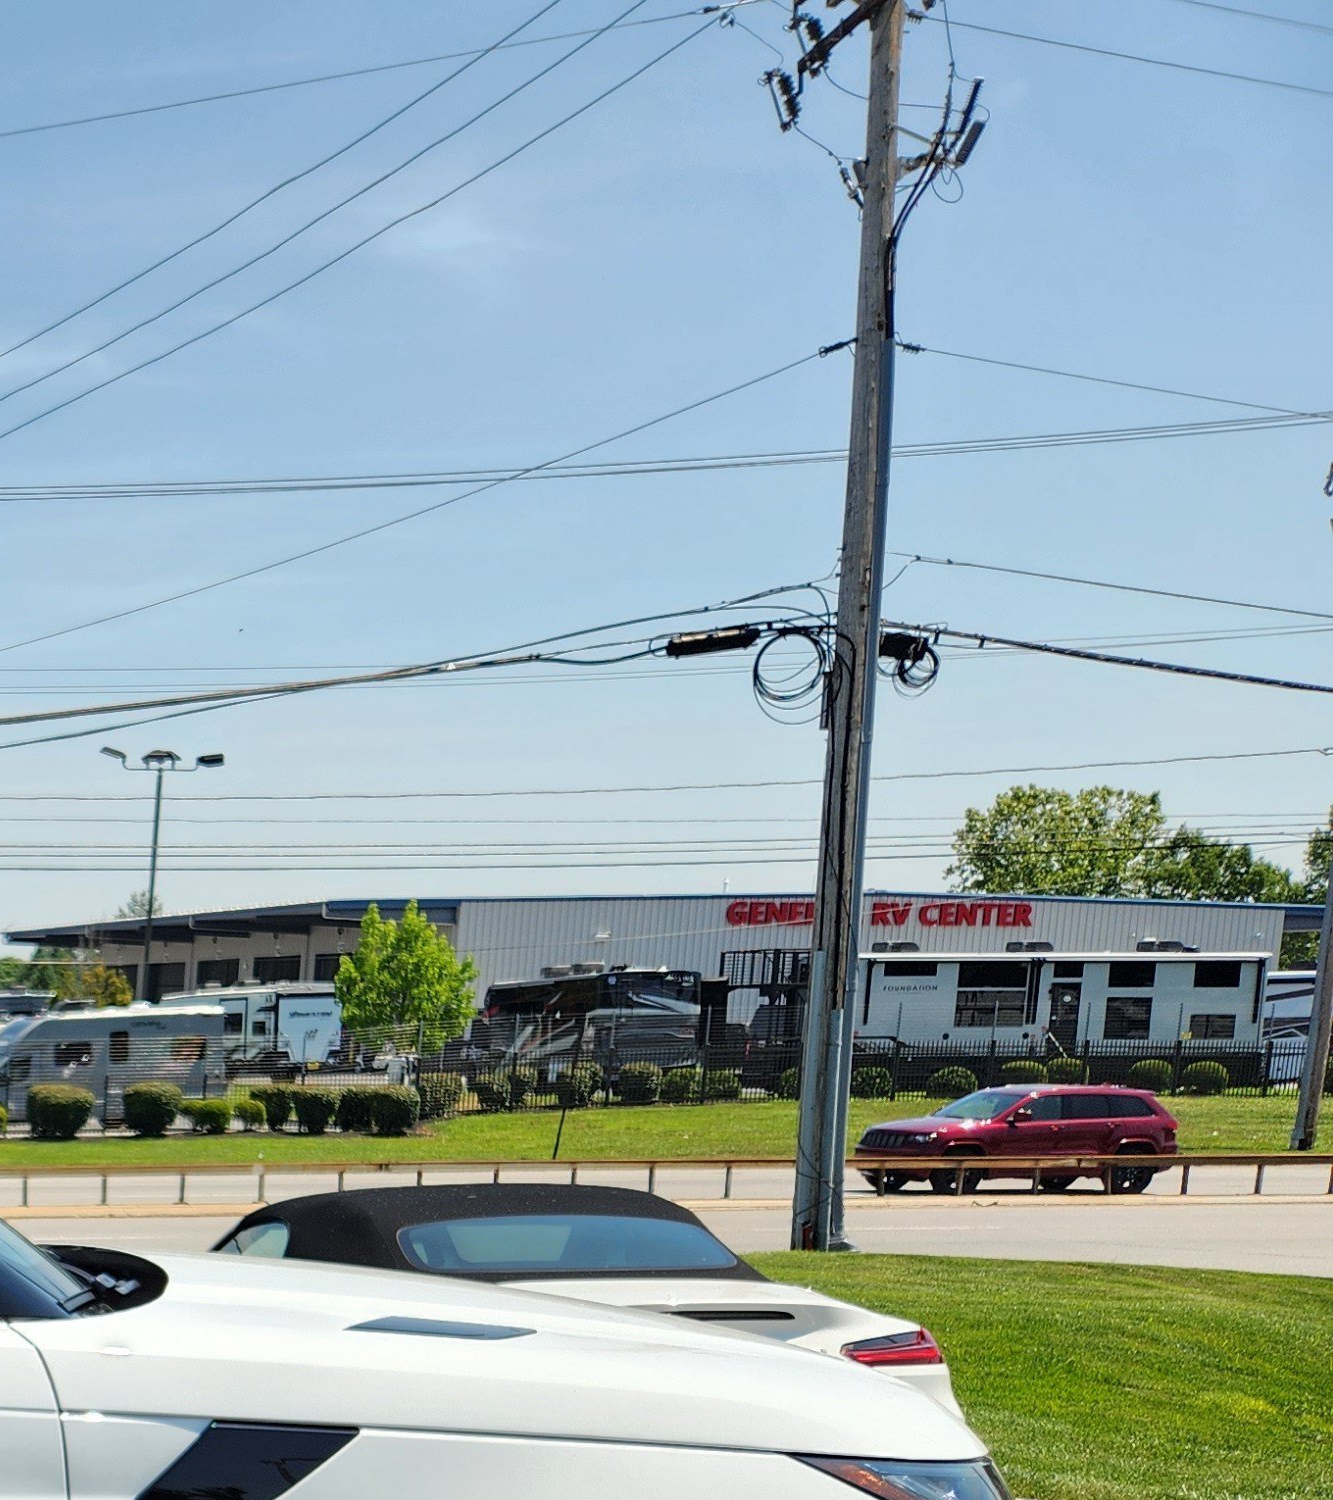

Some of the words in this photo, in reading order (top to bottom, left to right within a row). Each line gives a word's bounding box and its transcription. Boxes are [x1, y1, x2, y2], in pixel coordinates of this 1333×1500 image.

[726, 902, 815, 926] GENE
[871, 902, 913, 927] RV
[919, 903, 1033, 928] CENTER
[882, 984, 938, 992] FOUNDATION
